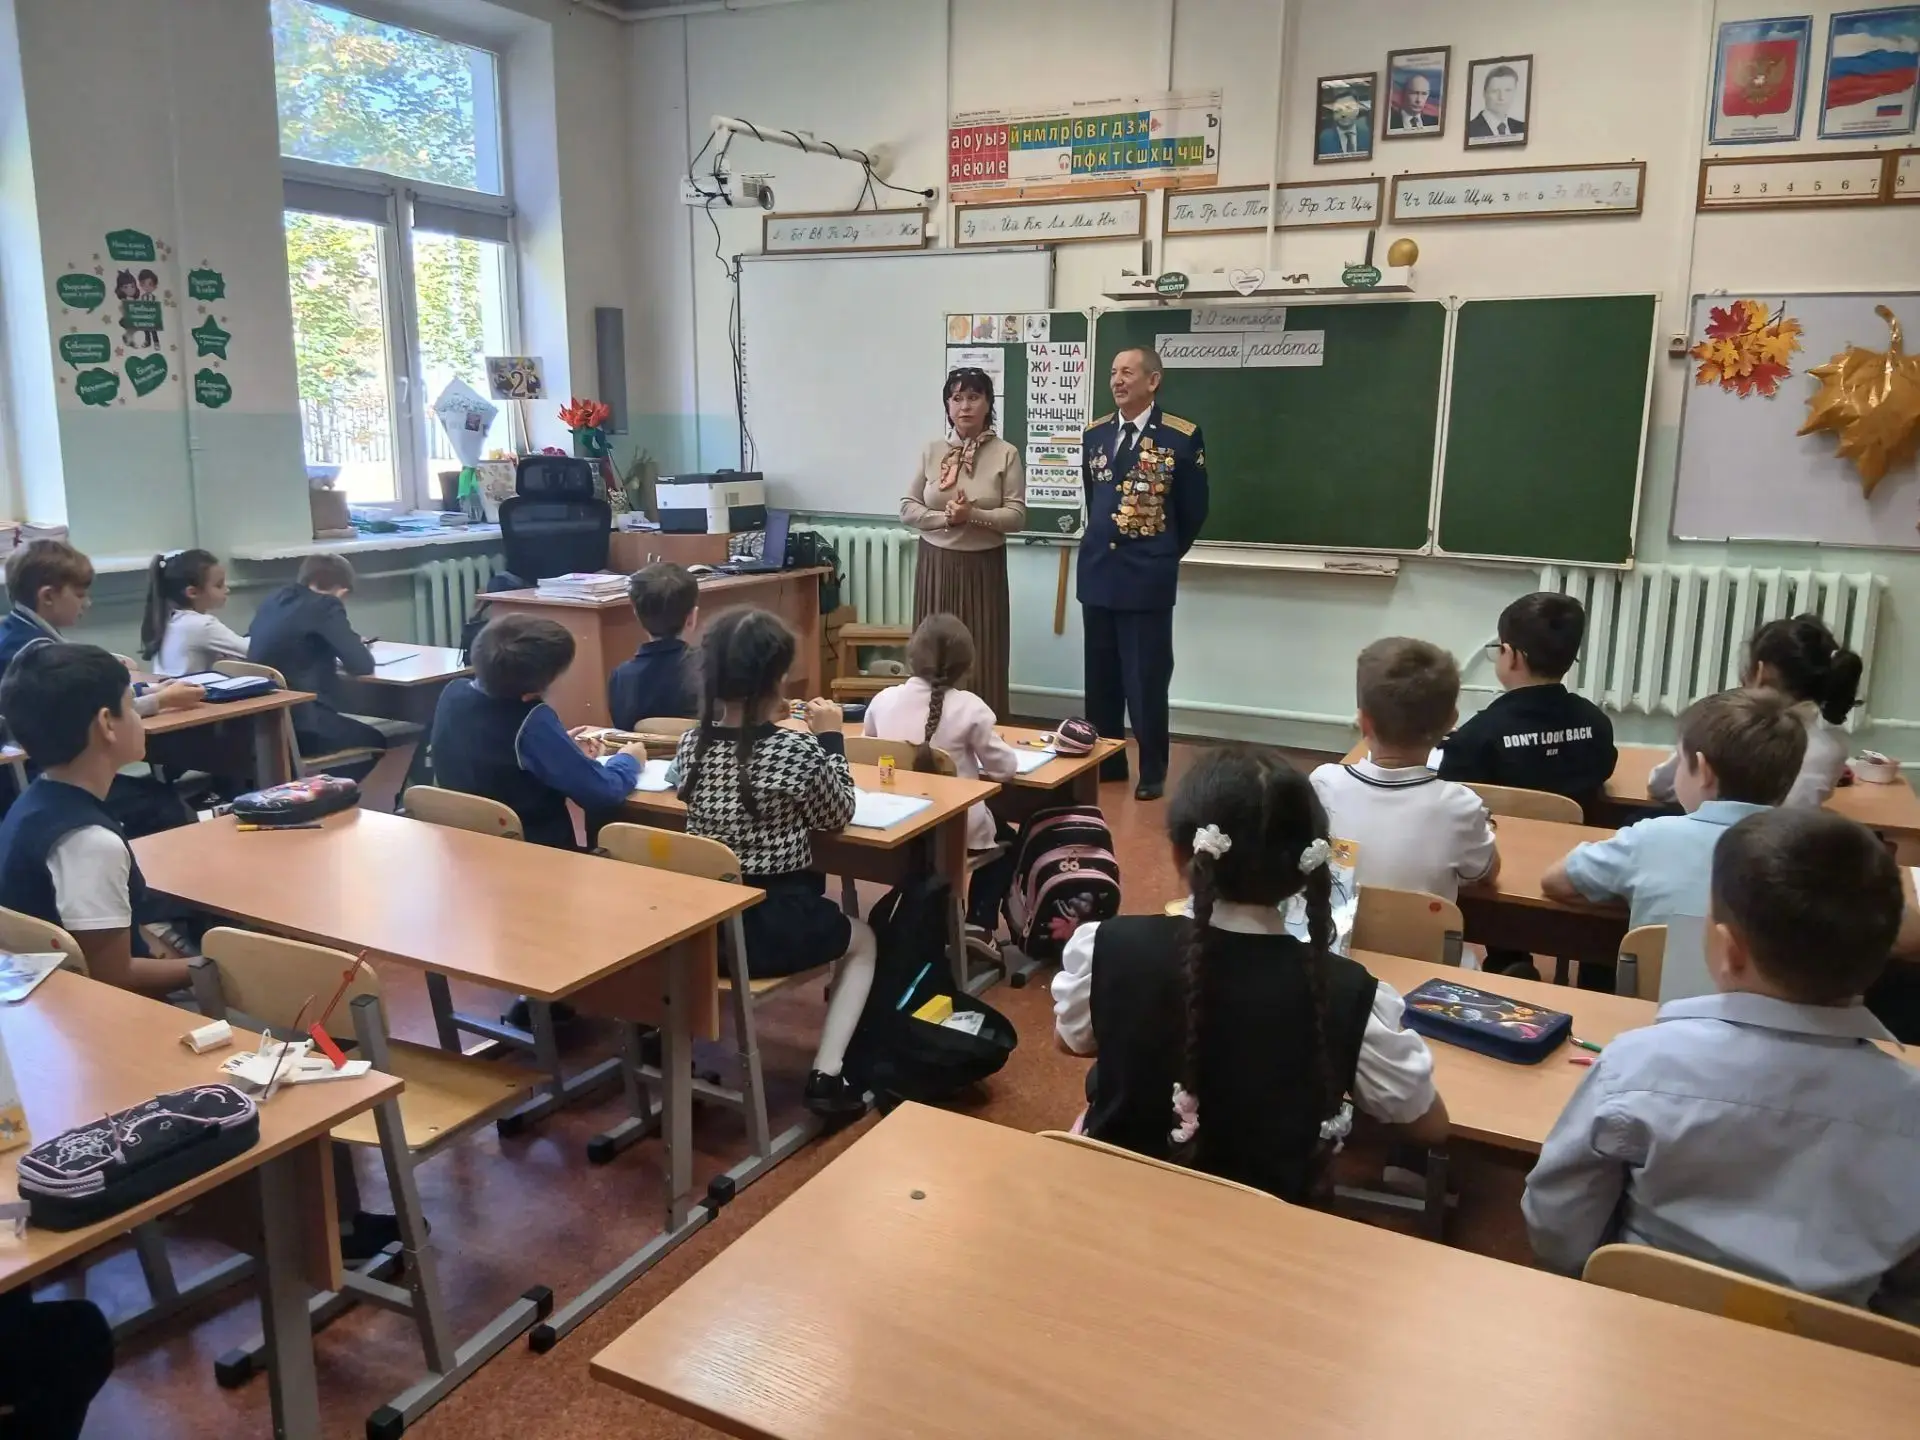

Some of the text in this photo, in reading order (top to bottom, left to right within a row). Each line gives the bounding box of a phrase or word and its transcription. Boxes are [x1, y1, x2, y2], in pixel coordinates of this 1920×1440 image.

[1708, 178, 1877, 194] 1 2 3 4 5 6 7
[1897, 176, 1905, 186] 8
[1031, 344, 1048, 356] ЧА
[1059, 344, 1081, 357] ЩА
[1158, 336, 1239, 358] Классная
[1031, 361, 1051, 373] ЖИ
[1063, 361, 1085, 373] ШИ
[511, 370, 526, 398] 2
[1031, 376, 1048, 388] ЧУ
[1060, 376, 1081, 389] ЩУ
[1031, 393, 1048, 405] ЧК
[1059, 393, 1076, 405] ЧН
[1503, 727, 1592, 748] DON'T LOOK BACK
